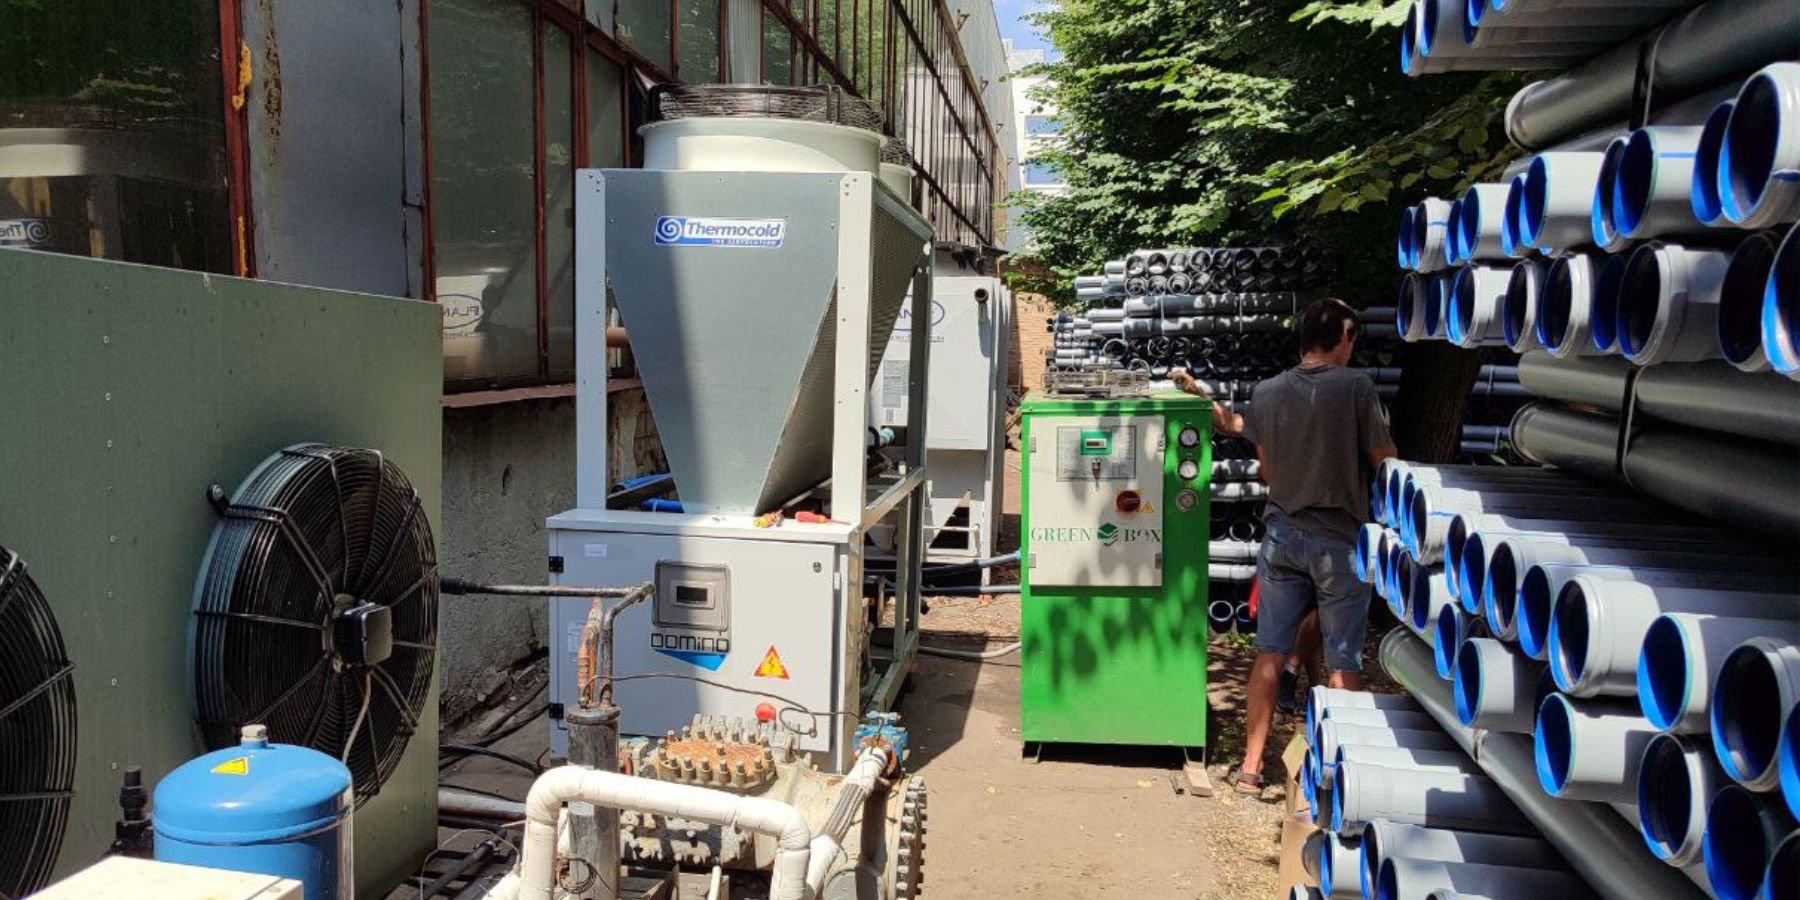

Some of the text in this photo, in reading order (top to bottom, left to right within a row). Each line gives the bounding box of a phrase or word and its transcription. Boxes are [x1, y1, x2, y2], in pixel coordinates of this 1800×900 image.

[687, 222, 780, 237] Thermocold
[1031, 527, 1161, 541] GREEN BOX
